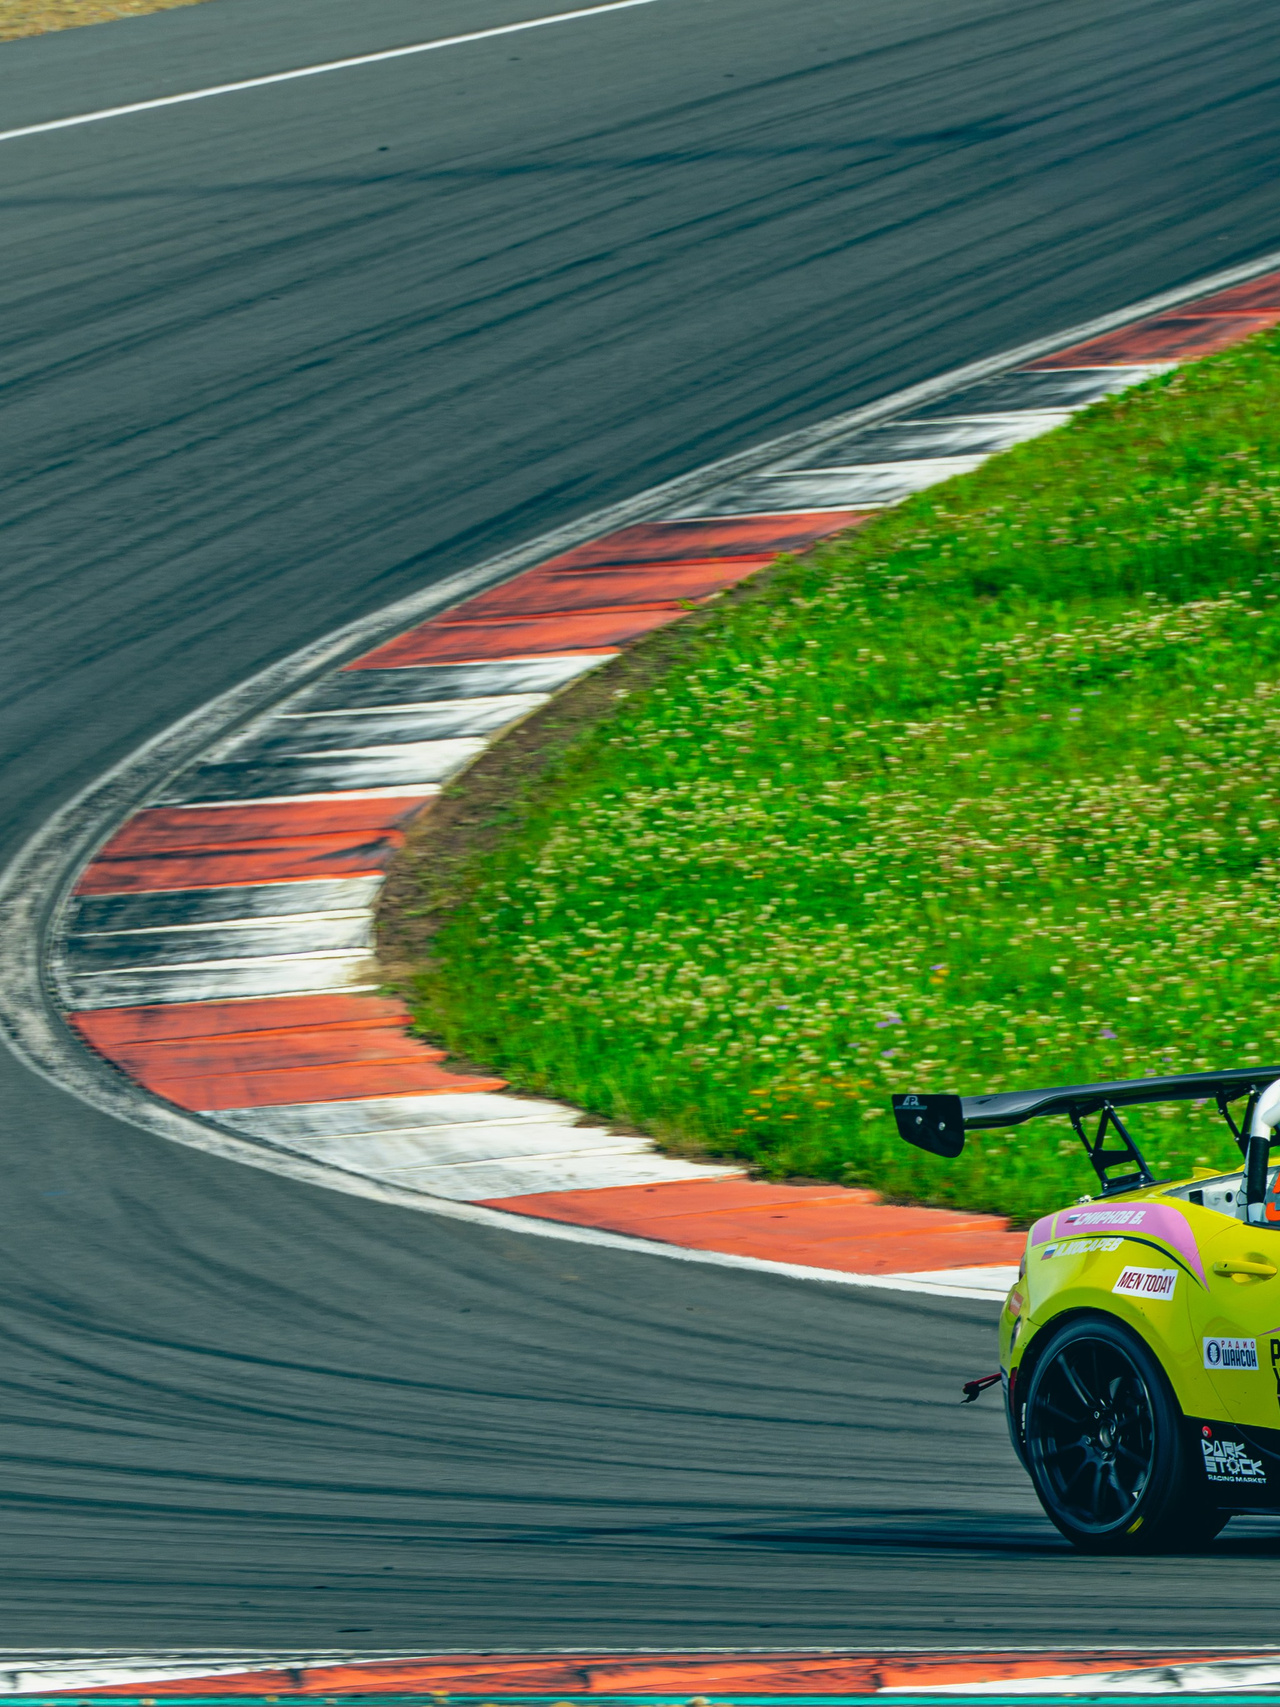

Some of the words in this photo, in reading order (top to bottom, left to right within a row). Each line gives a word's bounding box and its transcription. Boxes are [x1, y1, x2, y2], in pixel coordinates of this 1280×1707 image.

[1117, 1272, 1144, 1290] MEN
[1142, 1274, 1175, 1294] TODAY
[1221, 1340, 1255, 1349] РАДИО
[1222, 1349, 1258, 1367] ШАНСОН
[1201, 1439, 1247, 1458] DARK
[1204, 1455, 1266, 1476] STOCK
[1207, 1474, 1235, 1482] RACING
[1235, 1476, 1267, 1484] MARKET
